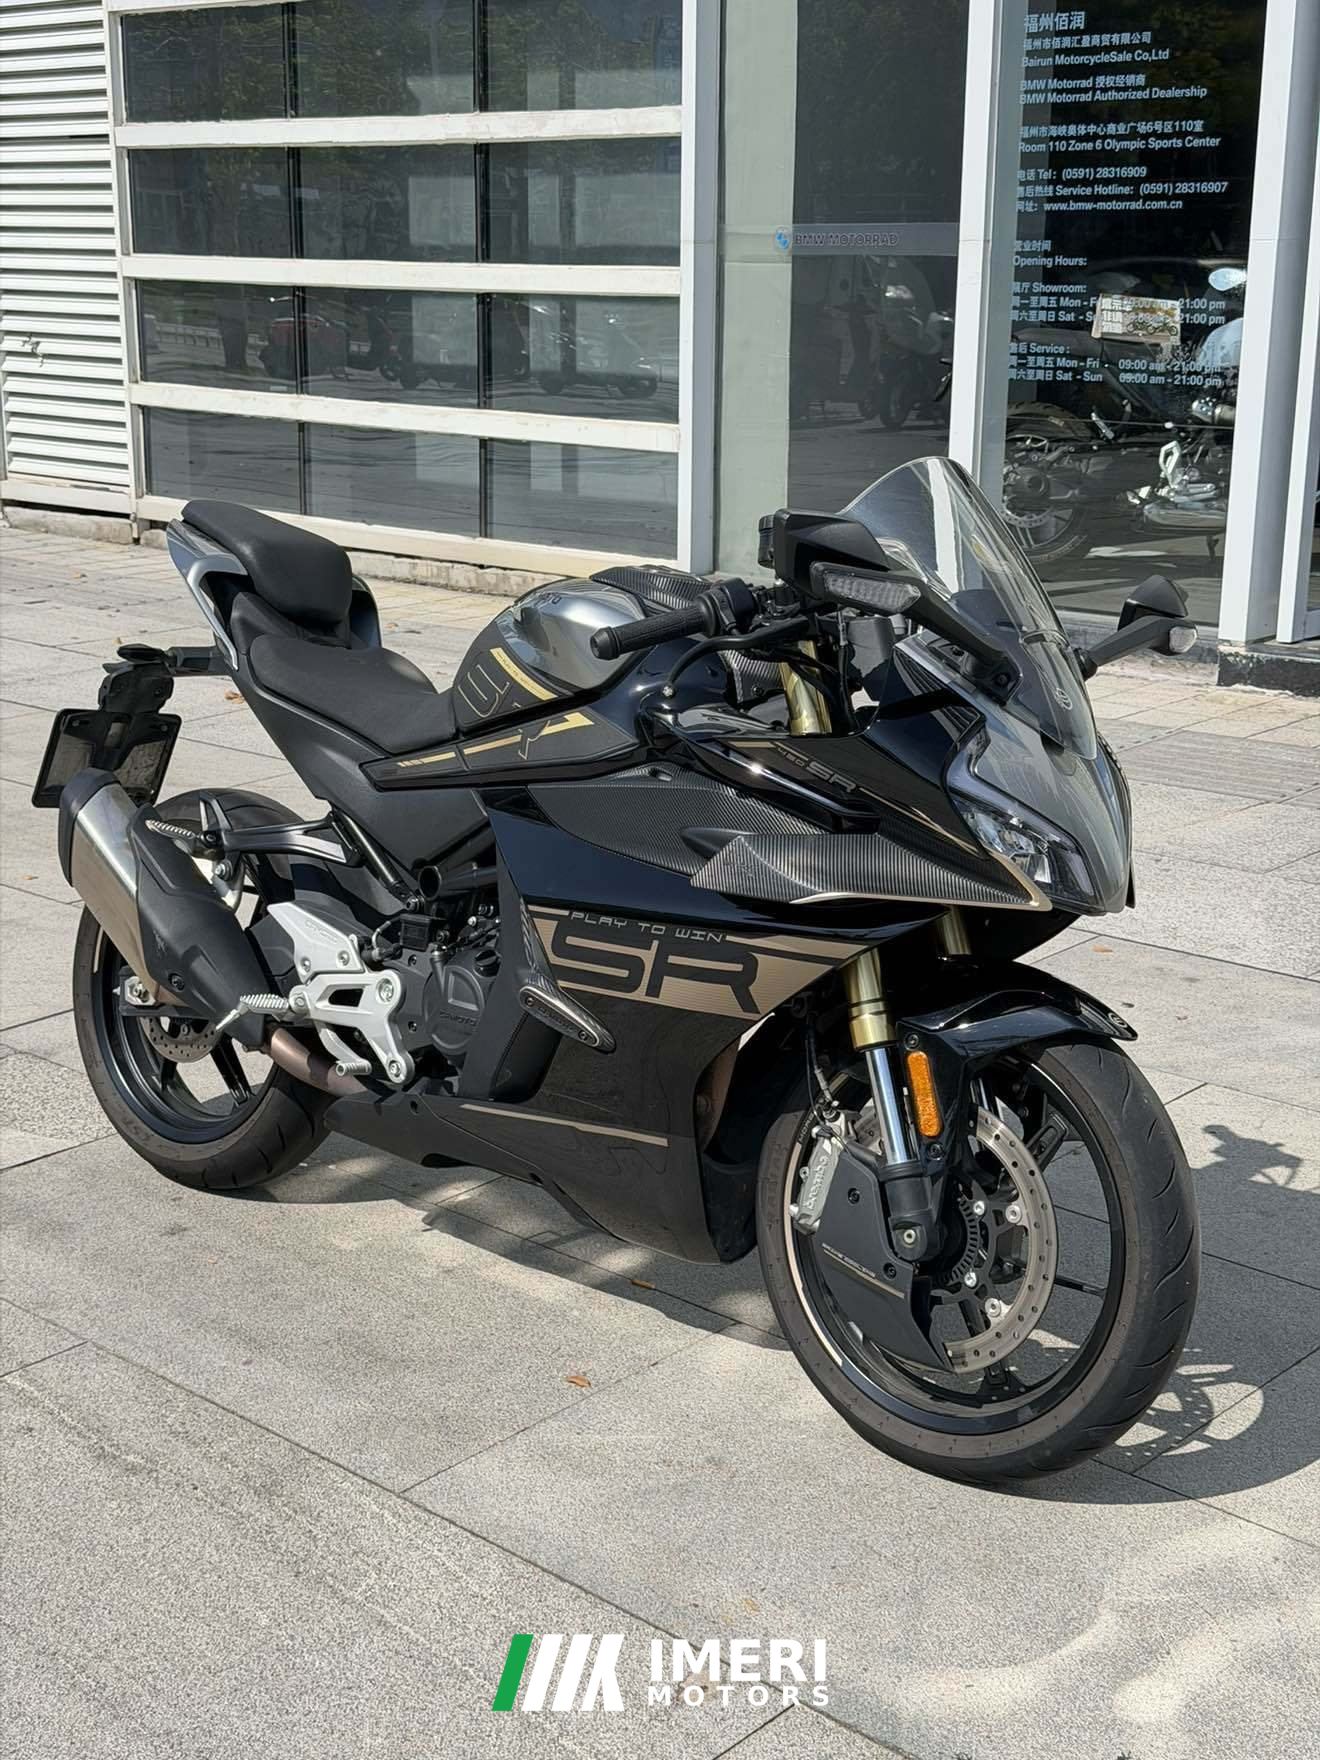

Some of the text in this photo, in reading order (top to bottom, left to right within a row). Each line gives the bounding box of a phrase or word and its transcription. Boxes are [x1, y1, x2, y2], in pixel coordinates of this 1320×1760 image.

[1023, 12, 1085, 33] 福州佰润
[1023, 55, 1053, 67] Bairun
[1055, 51, 1133, 66] MotorcycleSale
[1020, 74, 1146, 91] BMW Motorrad 授权经销商
[1020, 86, 1207, 104] BMW Motorrad Authorized Dealership
[1019, 136, 1221, 153] Room 110 Zone 6 Olympic Sports Center
[1062, 168, 1094, 181] (0591)
[1096, 166, 1147, 178] 28316909
[1055, 184, 1092, 196] Service
[1139, 183, 1173, 196] (0591)
[1175, 181, 1228, 194] 28316907
[1043, 199, 1183, 212] www.bmw-motorrad.com.cn
[795, 232, 899, 246] BMW MOTORRAD
[1012, 255, 1087, 268] Opening Hours:
[1032, 281, 1087, 293] Showroom:
[1060, 297, 1081, 307] Mon
[1178, 297, 1207, 309] 21:00
[1208, 300, 1226, 312] pm
[1058, 311, 1075, 322] Sat
[1177, 313, 1206, 324] 21:00
[1207, 315, 1225, 326] pm
[1057, 357, 1078, 368] Mon
[1086, 358, 1100, 369] Fri
[1118, 358, 1147, 371] 09:00
[1055, 370, 1072, 381] Sat
[1083, 371, 1103, 382] Sun
[1149, 376, 1165, 385] am
[1174, 374, 1203, 386] 21:00
[1204, 377, 1222, 389] pm
[570, 910, 723, 943] PLAY TO WIN
[550, 919, 760, 1014] SR
[804, 1155, 829, 1209] brembo
